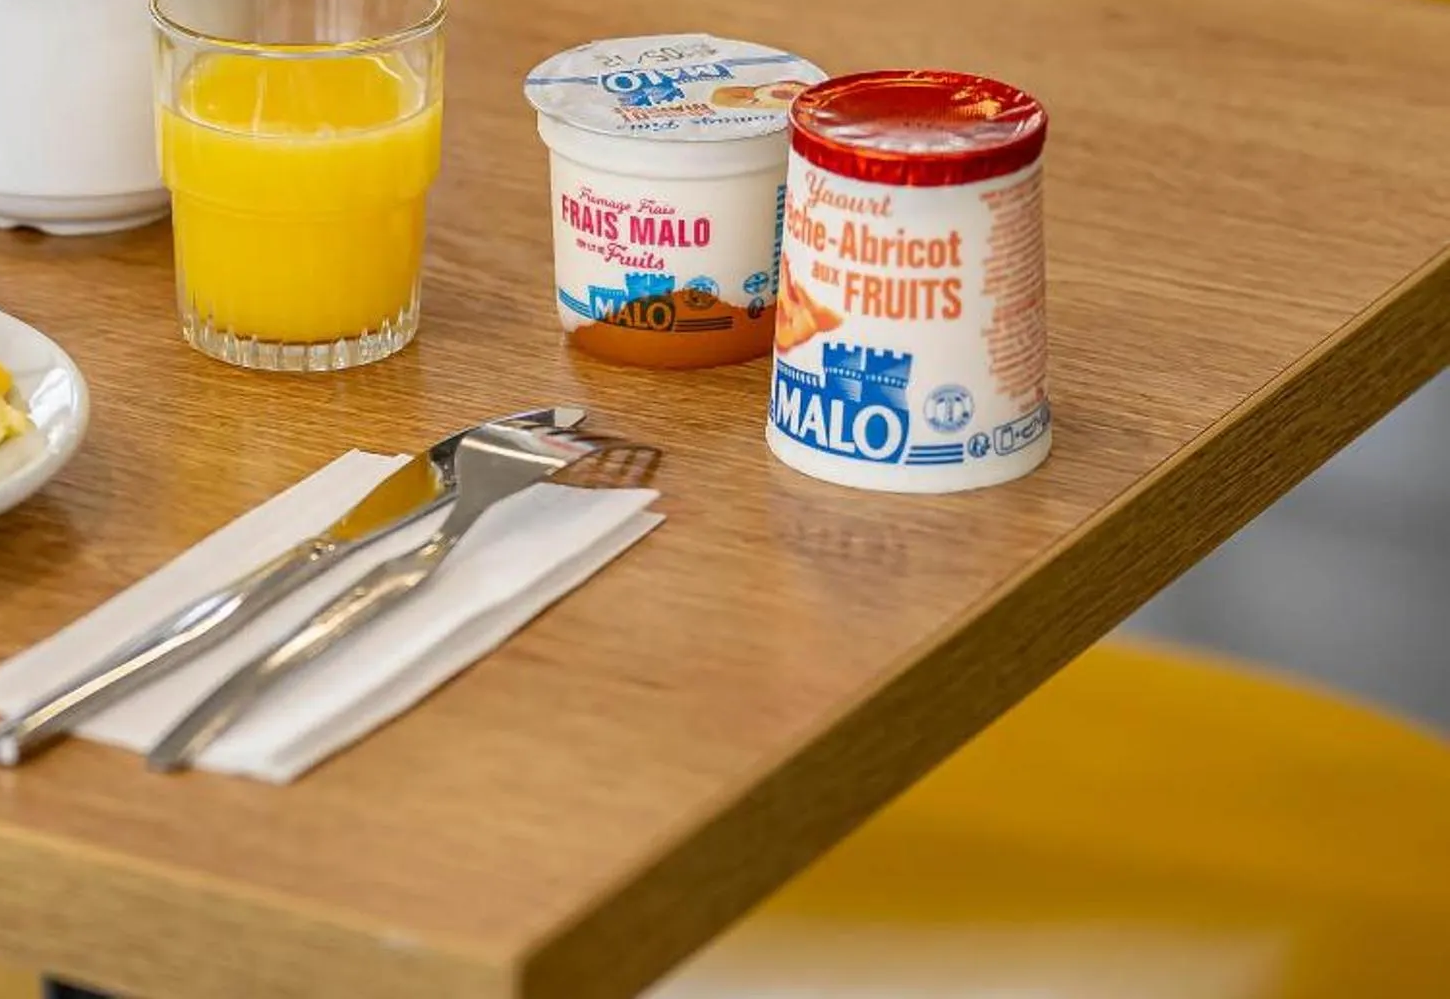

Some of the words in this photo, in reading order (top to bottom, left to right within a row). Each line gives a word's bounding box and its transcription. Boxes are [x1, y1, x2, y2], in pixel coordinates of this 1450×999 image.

[606, 64, 728, 92] MALO
[805, 169, 893, 217] Yaourt
[561, 193, 619, 241] FRAIS
[629, 215, 711, 248] MALO
[603, 243, 665, 271] Fruits
[594, 295, 675, 331] MALO
[811, 260, 840, 287] aux
[843, 271, 963, 321] FRUITS
[776, 379, 903, 461] MALO
